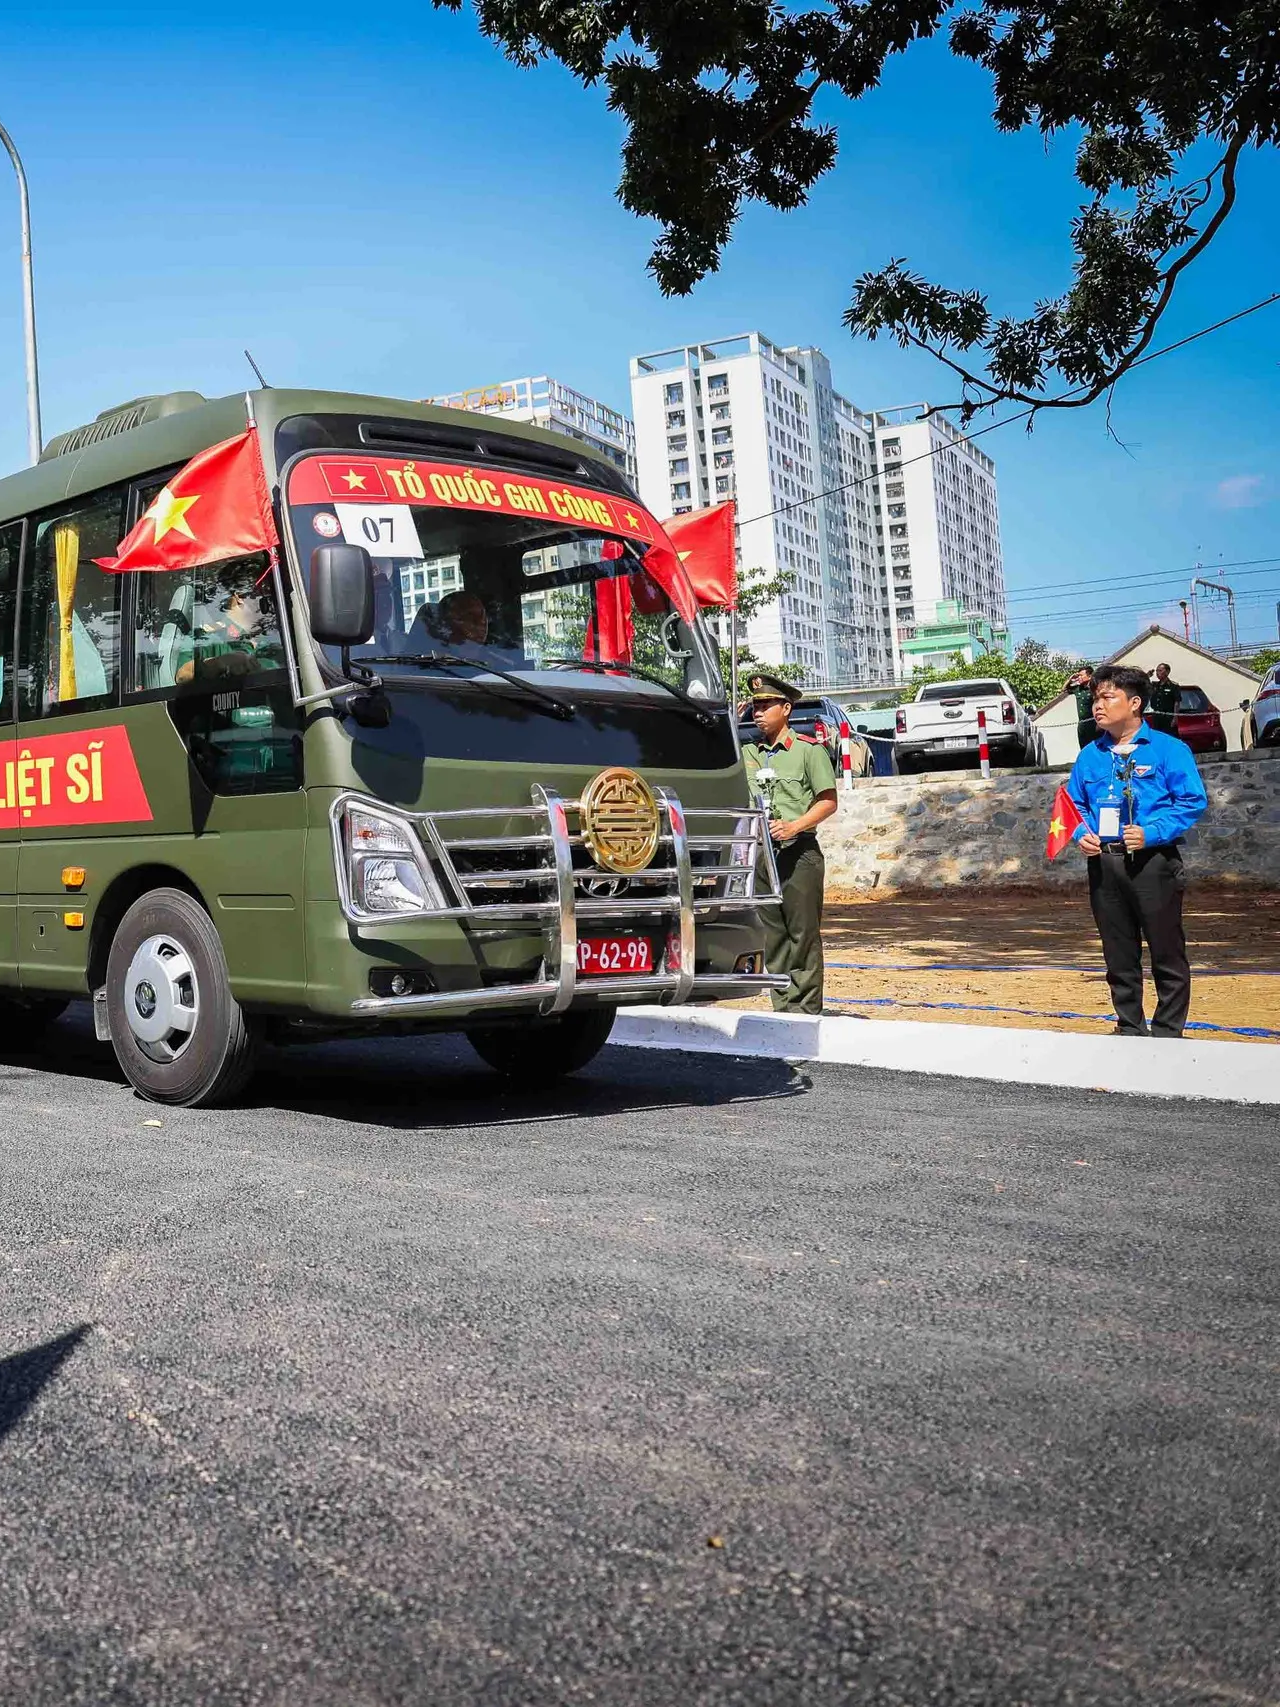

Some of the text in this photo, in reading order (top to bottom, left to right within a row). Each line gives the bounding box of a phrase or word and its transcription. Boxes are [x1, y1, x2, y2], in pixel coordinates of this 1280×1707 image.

[386, 461, 614, 528] TỔ QUỐC GHI CÔNG
[361, 516, 394, 543] 07
[212, 690, 240, 712] COUNTY
[66, 740, 104, 804] SĨ
